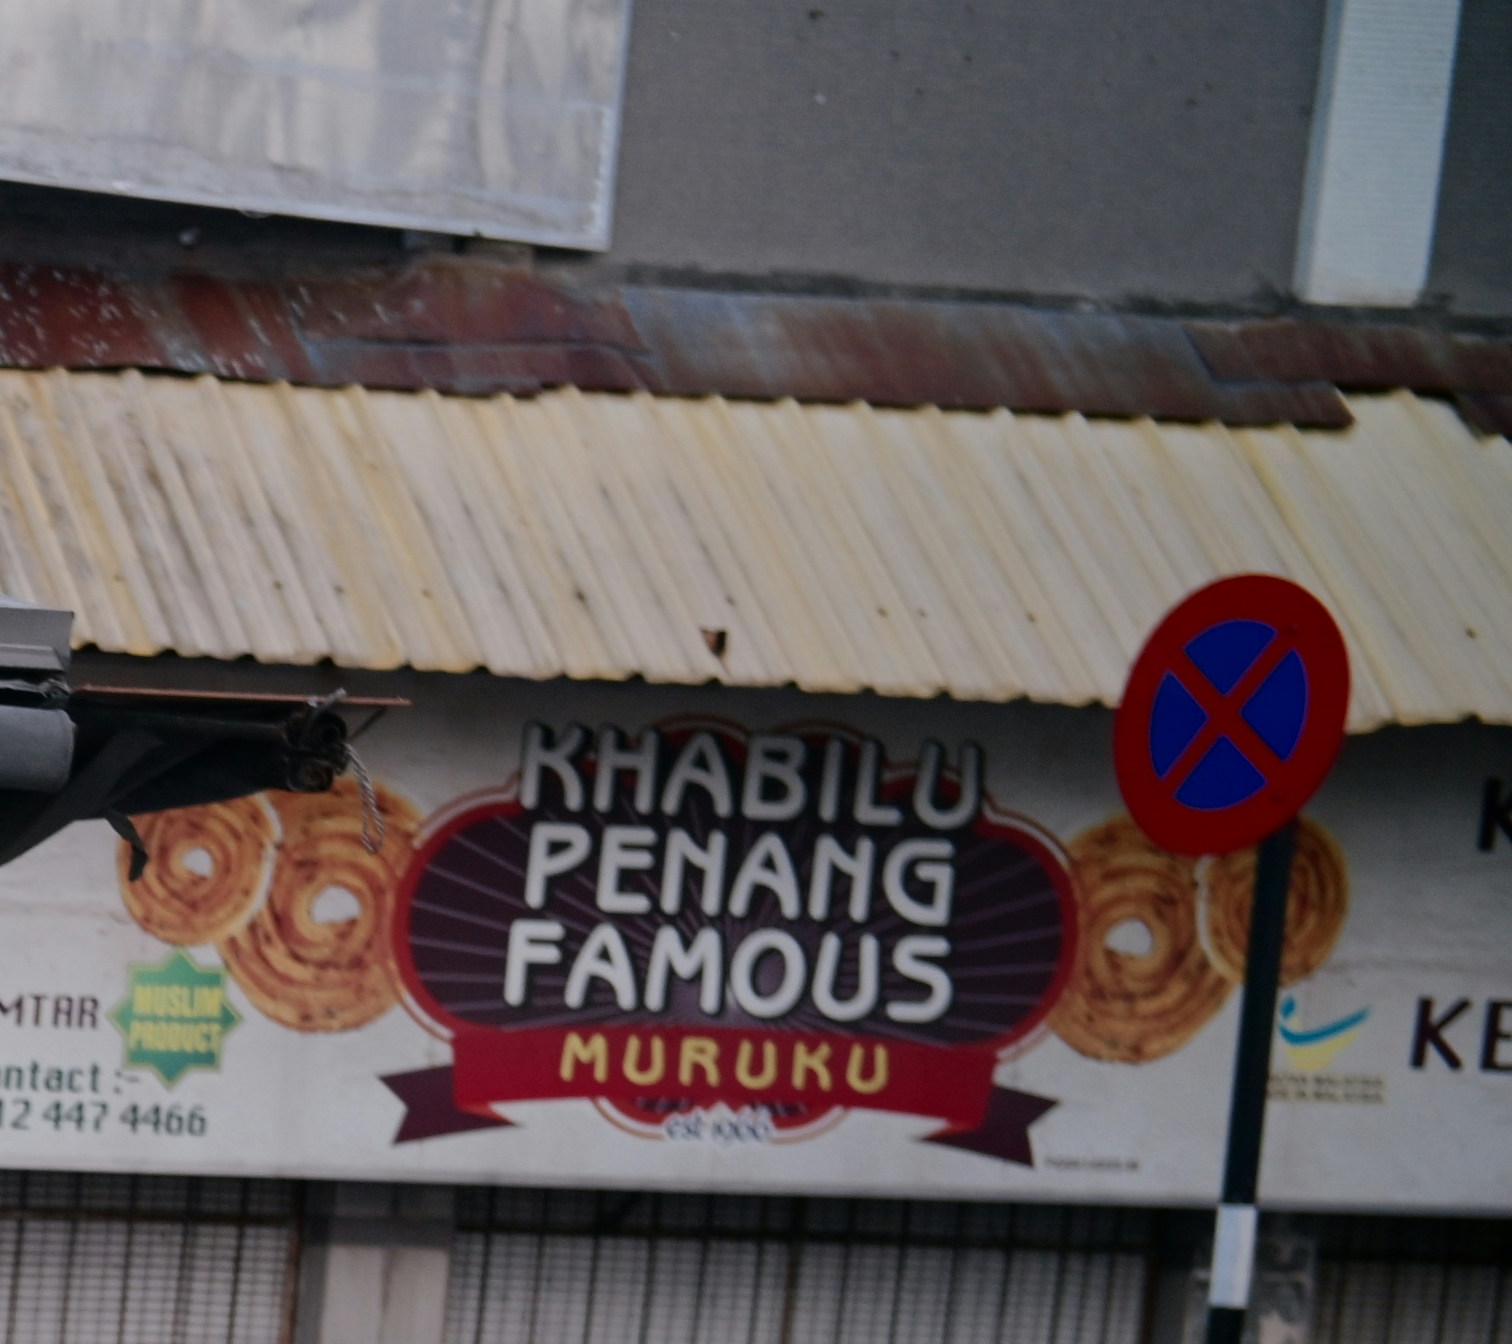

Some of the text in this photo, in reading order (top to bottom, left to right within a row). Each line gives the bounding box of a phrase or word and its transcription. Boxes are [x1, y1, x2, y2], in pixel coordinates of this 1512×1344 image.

[519, 720, 983, 831] KHABILU
[524, 821, 958, 929] PENANG
[134, 985, 222, 1017] MUSLIM
[503, 917, 954, 1023] FAMOUS
[129, 1020, 221, 1053] PRODUCT
[559, 1031, 890, 1095] MURUKU
[42, 1101, 109, 1132] 447
[120, 1104, 207, 1137] 4466
